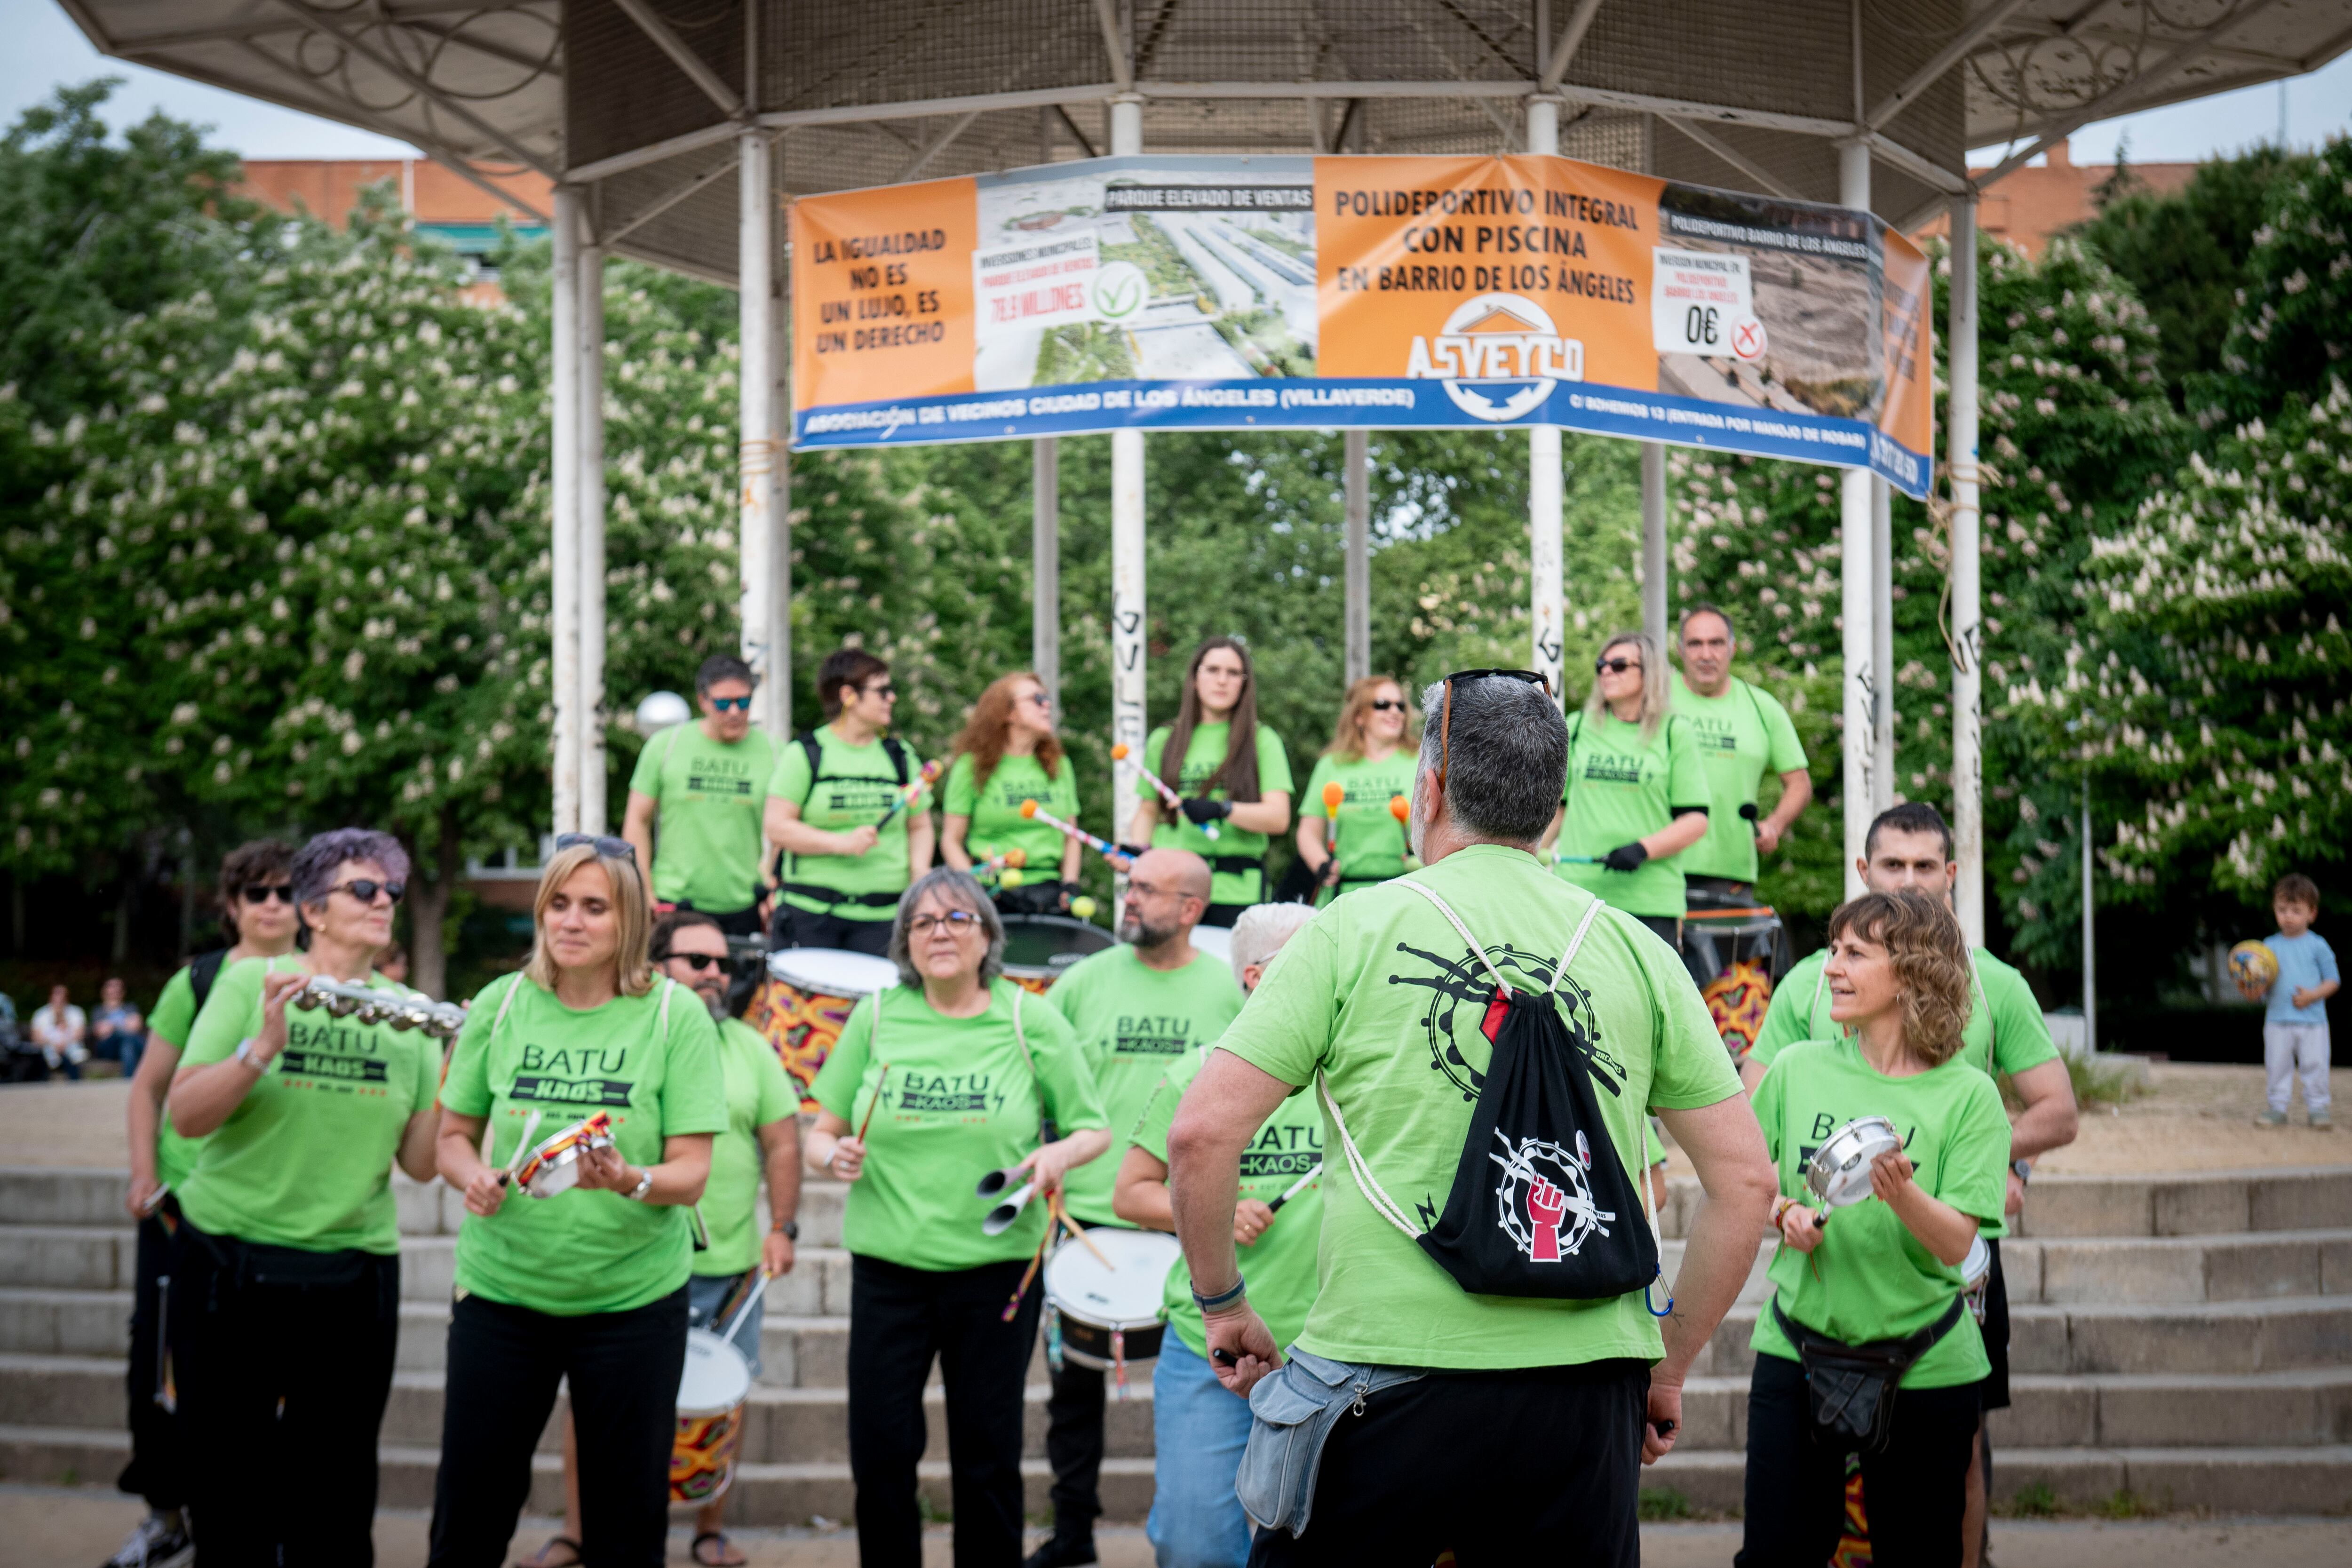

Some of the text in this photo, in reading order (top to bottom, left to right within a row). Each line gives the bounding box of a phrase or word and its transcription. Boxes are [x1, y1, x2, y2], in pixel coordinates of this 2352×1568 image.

[1107, 189, 1312, 207] PARQUE ELEVADO DE VENTAS
[1335, 189, 1639, 231] POLIDEPORTIVO INTEGRAL
[813, 229, 946, 264] LA IGUALDAD
[1404, 225, 1587, 259] CON PISCINA
[1671, 215, 1747, 242] POLIDEPORTIVO
[1747, 227, 1786, 247] BARRIO
[1786, 233, 1801, 249] DE
[1801, 236, 1822, 253] LOS
[851, 263, 908, 291] NO ES
[1338, 260, 1635, 304] EN BARRIO DE LOS ÁNGELES
[820, 290, 939, 324] UN LUJO, ES
[817, 320, 945, 354] UN DERECHO
[1687, 305, 1719, 344] 0€
[918, 406, 946, 424] DE
[946, 398, 1027, 422] VECINOS
[1028, 392, 1102, 415] CIUDAD
[1103, 390, 1132, 409] DE
[1133, 389, 1177, 408] LOS
[1181, 386, 1278, 407] ÁNGELES
[1279, 388, 1415, 410] (VILLAVERDE)
[1588, 753, 1644, 768] BATU
[289, 1021, 378, 1056] BATU
[1117, 1016, 1191, 1036] BATU
[302, 1055, 366, 1079] KAOS
[522, 1044, 626, 1075] BATU
[1596, 1050, 1622, 1074] ORCAAS
[533, 1079, 605, 1103] KAOS
[905, 1071, 989, 1093] BATU
[915, 1095, 971, 1110] KAOS
[1246, 1125, 1323, 1150] ATU
[1248, 1154, 1311, 1175] KAOS
